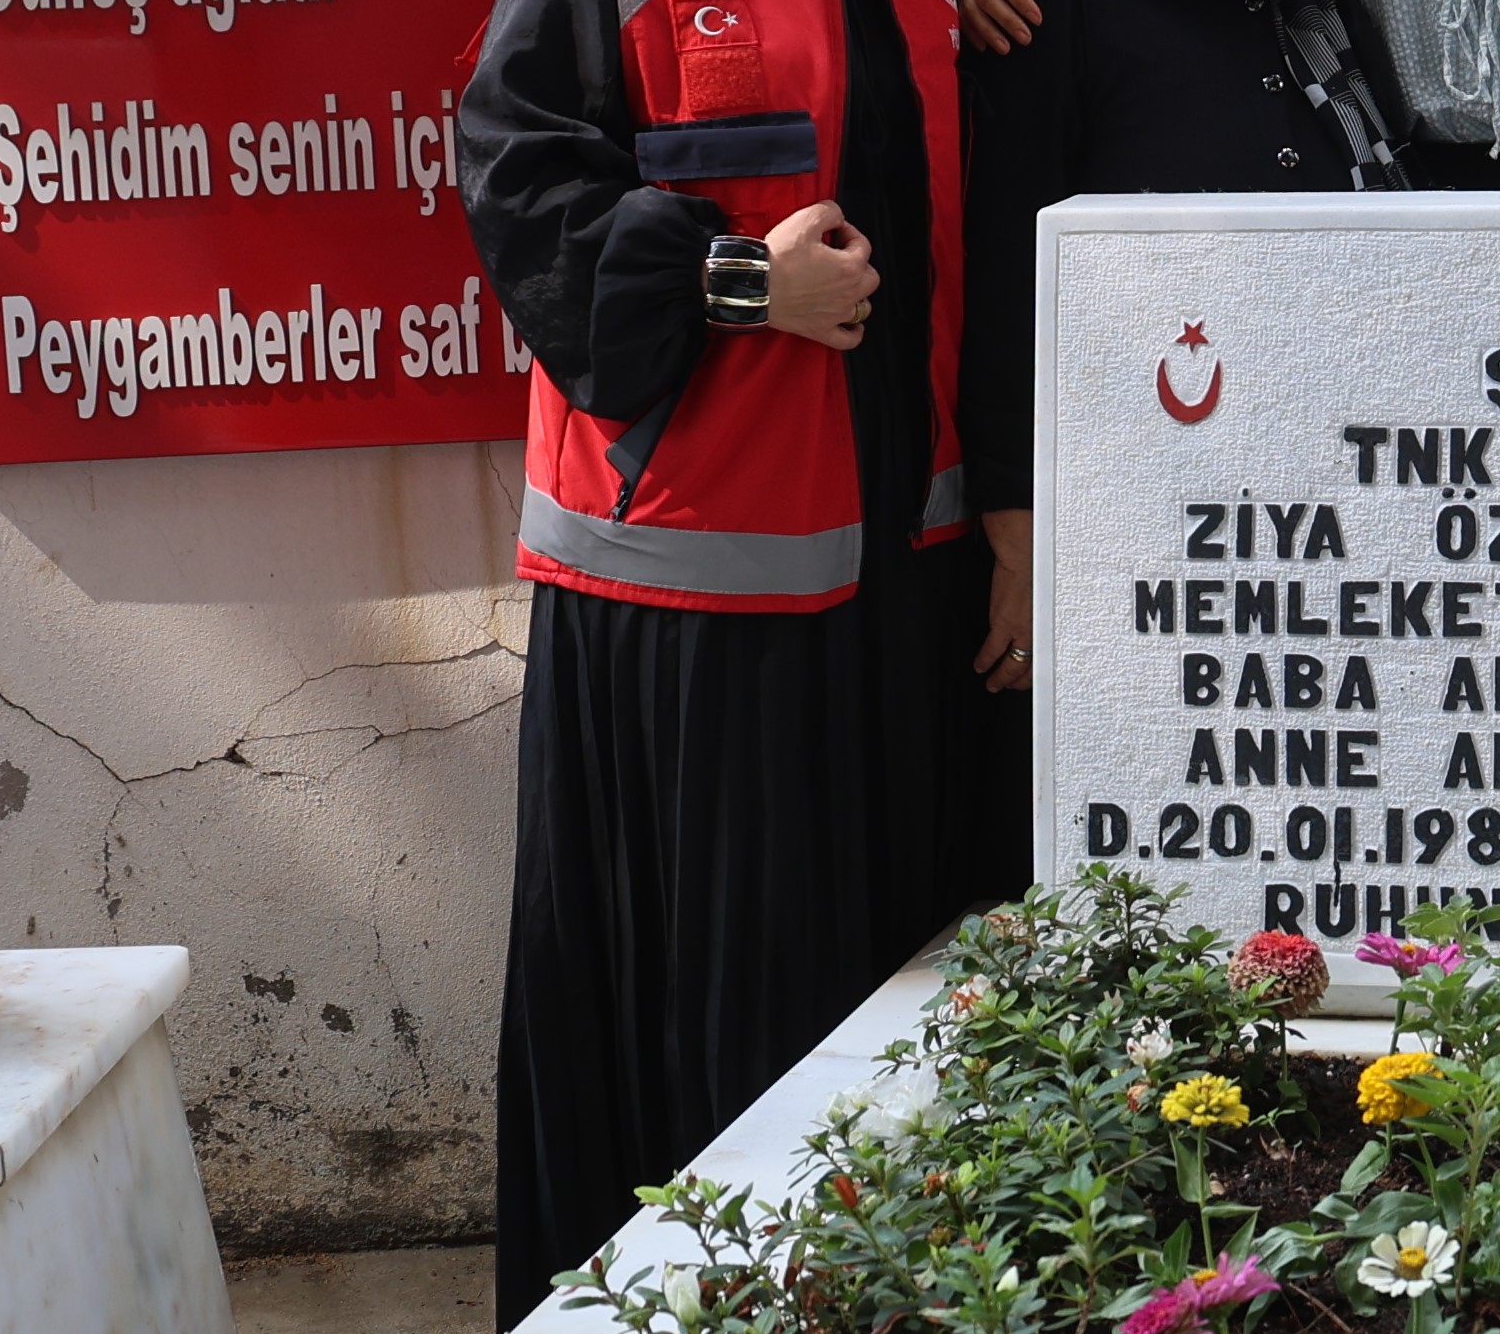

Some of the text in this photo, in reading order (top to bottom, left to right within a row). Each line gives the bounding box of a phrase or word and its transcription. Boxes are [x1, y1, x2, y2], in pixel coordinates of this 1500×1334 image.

[228, 93, 376, 197] senin
[390, 88, 458, 217] içi
[1, 283, 382, 420] Peygamberler
[400, 276, 482, 379] saf
[1185, 487, 1347, 560] ZİYA
[1182, 653, 1377, 710] BABA
[1184, 728, 1379, 788] ANNE
